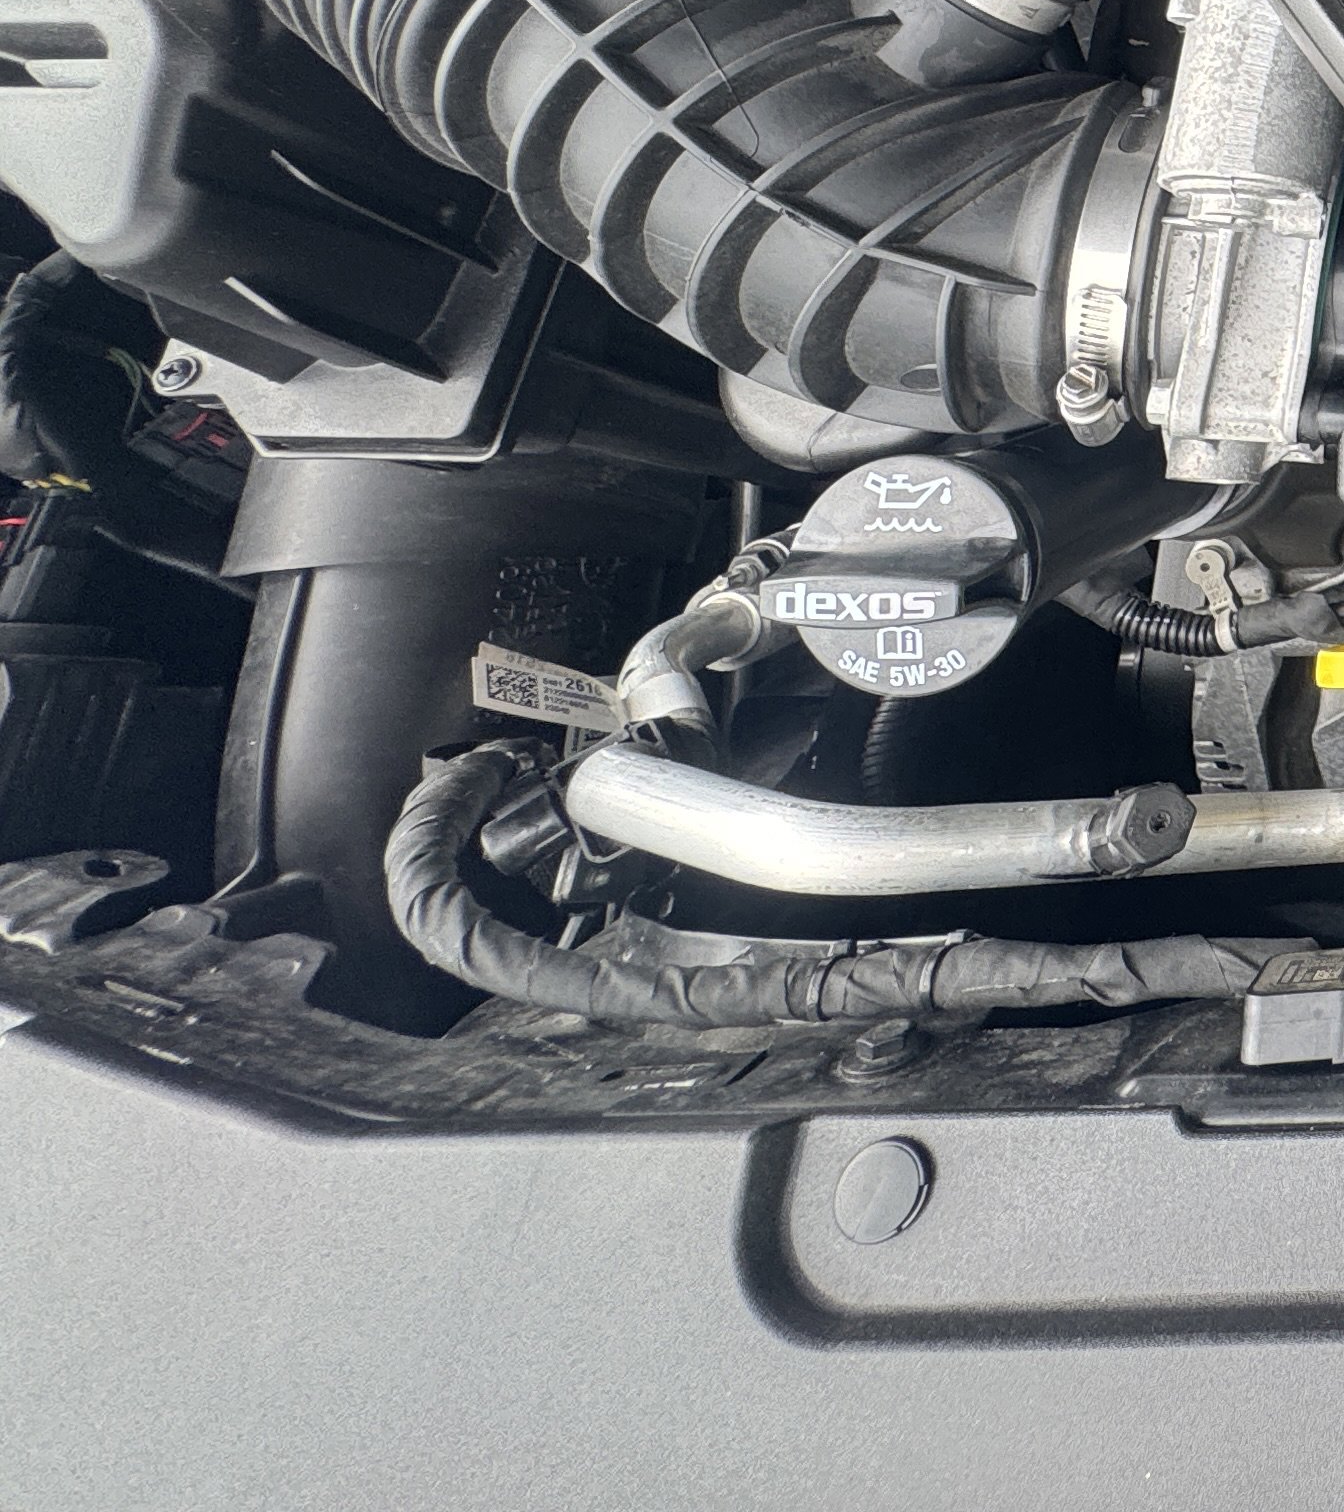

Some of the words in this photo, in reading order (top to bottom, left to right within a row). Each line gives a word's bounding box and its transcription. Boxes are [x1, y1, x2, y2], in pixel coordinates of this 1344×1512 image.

[776, 582, 940, 621] dexos
[838, 649, 881, 684] SAE
[889, 649, 967, 687] 5W-30
